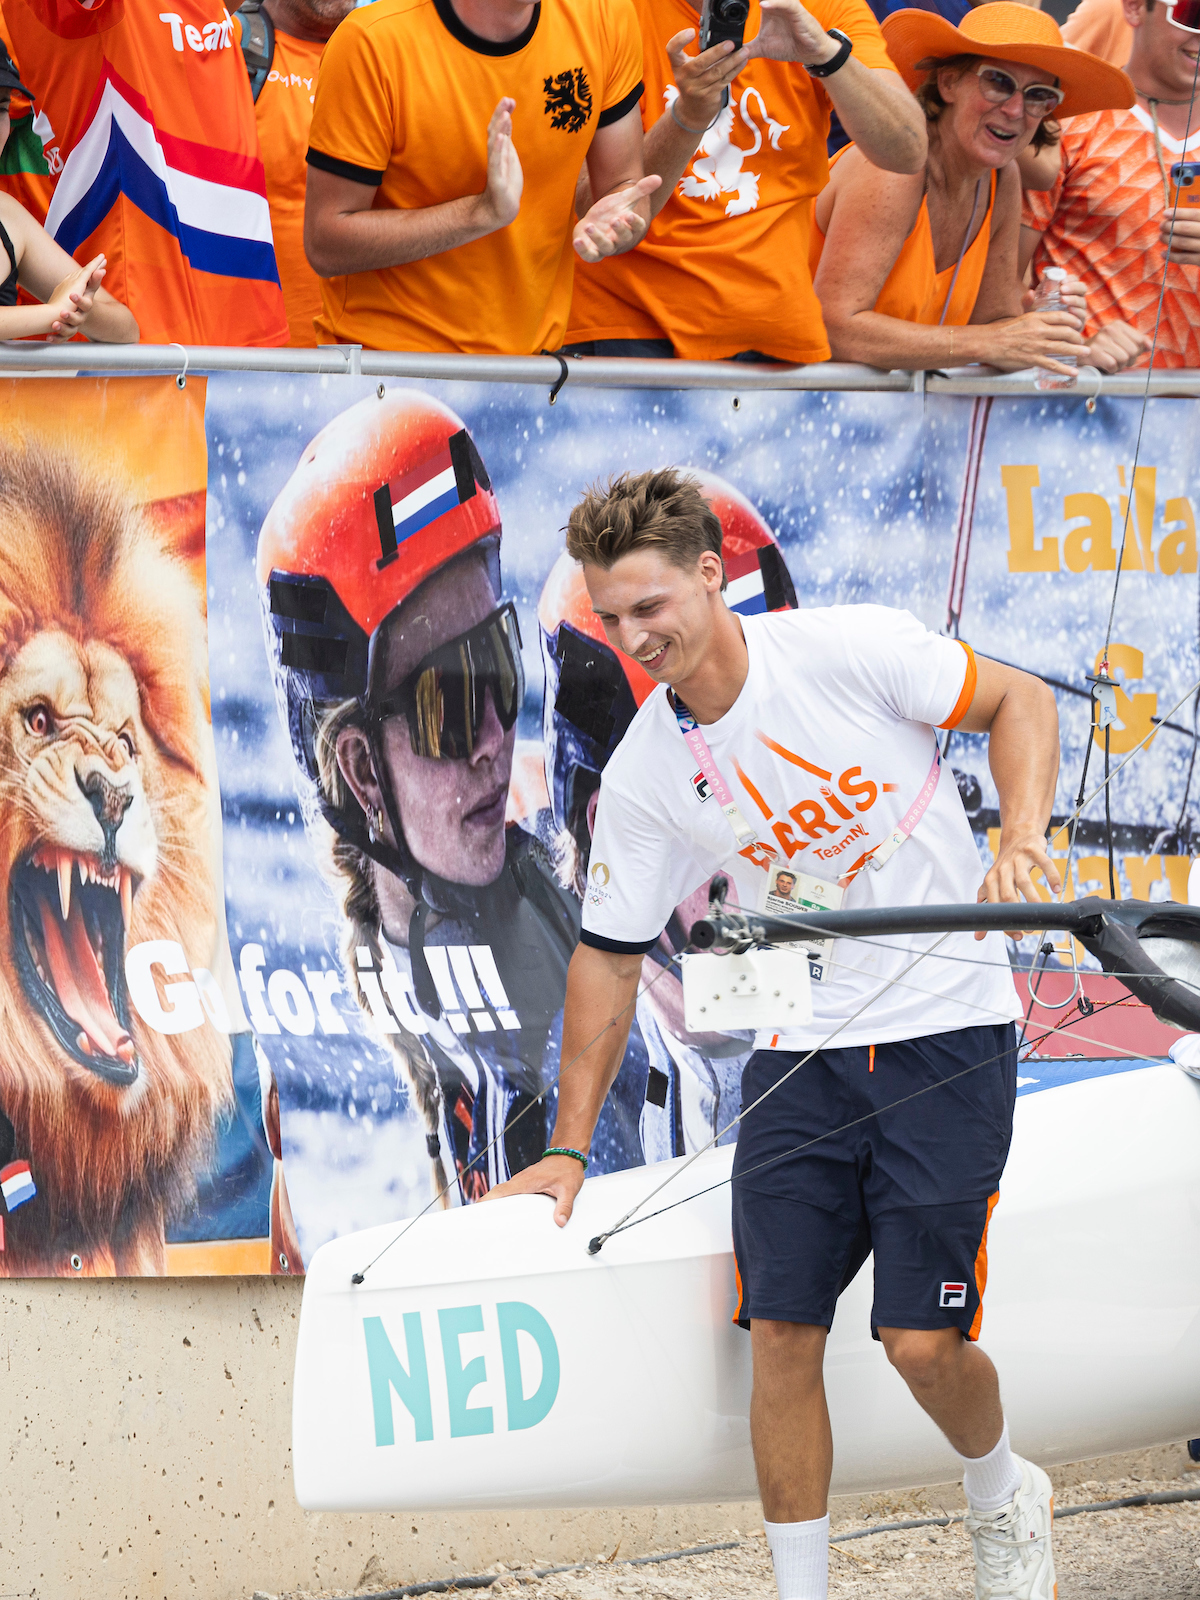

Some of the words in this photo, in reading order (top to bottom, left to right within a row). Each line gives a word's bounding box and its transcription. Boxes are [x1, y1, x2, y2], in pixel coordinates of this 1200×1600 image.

[159, 8, 234, 52] Team
[1001, 464, 1199, 576] Laila
[690, 735, 711, 769] PARIS
[708, 771, 727, 801] 2024
[904, 799, 926, 829] PARIS
[924, 769, 939, 798] 2024
[812, 823, 869, 860] TeamNL
[239, 943, 349, 1035] for
[356, 946, 429, 1034] it
[812, 966, 821, 977] R
[363, 1302, 560, 1447] NED
